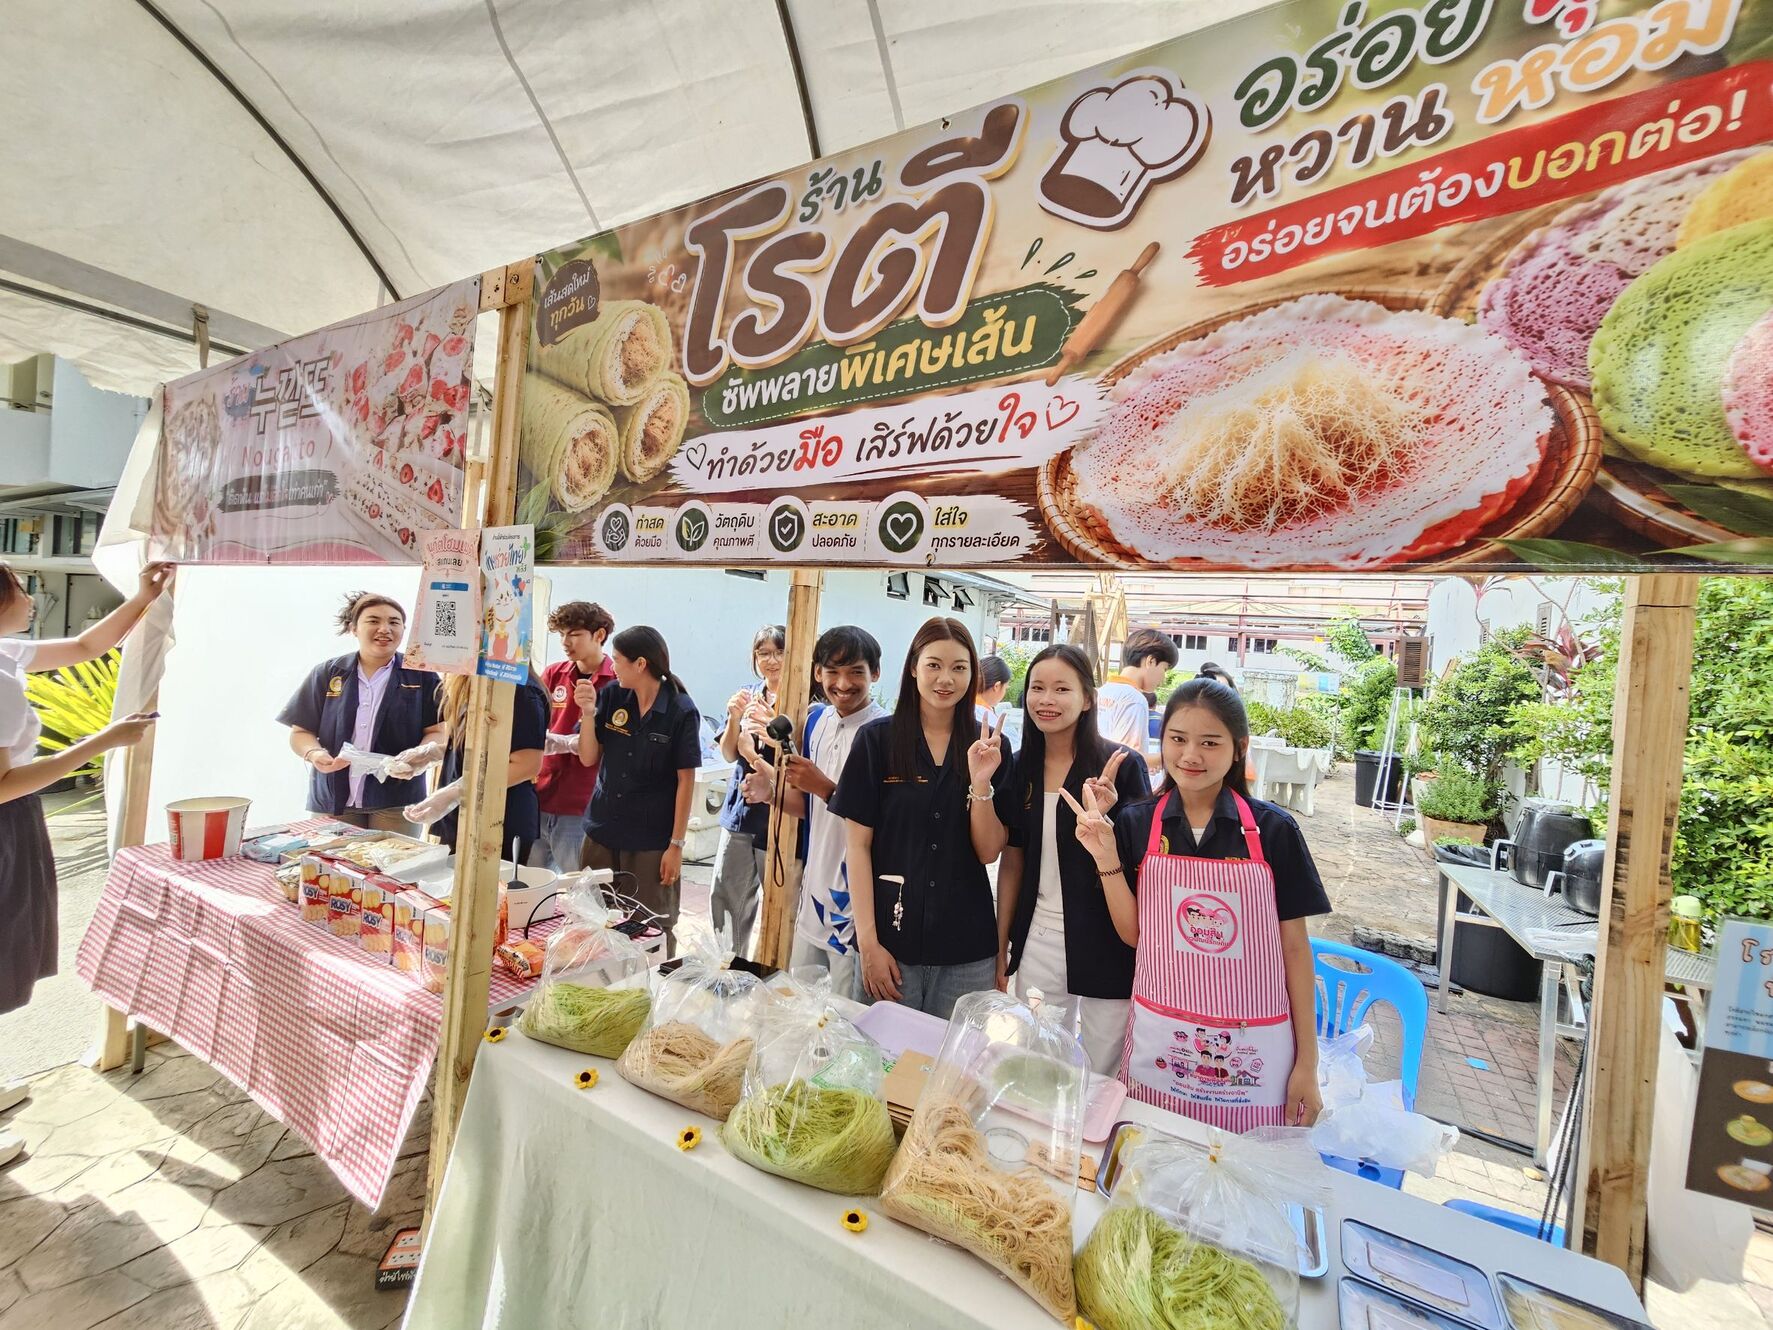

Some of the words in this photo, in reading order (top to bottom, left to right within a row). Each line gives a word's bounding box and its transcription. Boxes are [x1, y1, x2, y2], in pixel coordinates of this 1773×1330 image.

[1234, 0, 1491, 127] อร่อย
[1230, 88, 1449, 203] หวาน
[1479, 0, 1736, 117] หอม
[1221, 89, 1747, 270] อร่อยจนต้องบอกต่อ!
[799, 159, 882, 223] ร้าน
[685, 101, 1022, 382] โรตี
[544, 266, 591, 308] เส้นสดใหม่
[550, 296, 585, 331] ทุกวัน
[721, 308, 1038, 414] ซัพพลายพิเศษเส้น
[706, 424, 844, 480] ทำด้วยมือ
[855, 392, 1038, 462] เสิร์ฟด้วยใจ
[635, 514, 664, 529] ทำสด
[715, 512, 755, 533] วัตถุดิบ
[812, 512, 857, 527] สะอาด
[935, 506, 968, 526] ใส่ใจ
[634, 535, 662, 548] ด้วยมือ
[712, 534, 755, 551] คุณภาพดี
[812, 533, 857, 548] ปลอดภัย
[930, 531, 1020, 553] ทุกรายละเอียด
[330, 899, 351, 912] ROSY
[363, 912, 382, 927] ROSY
